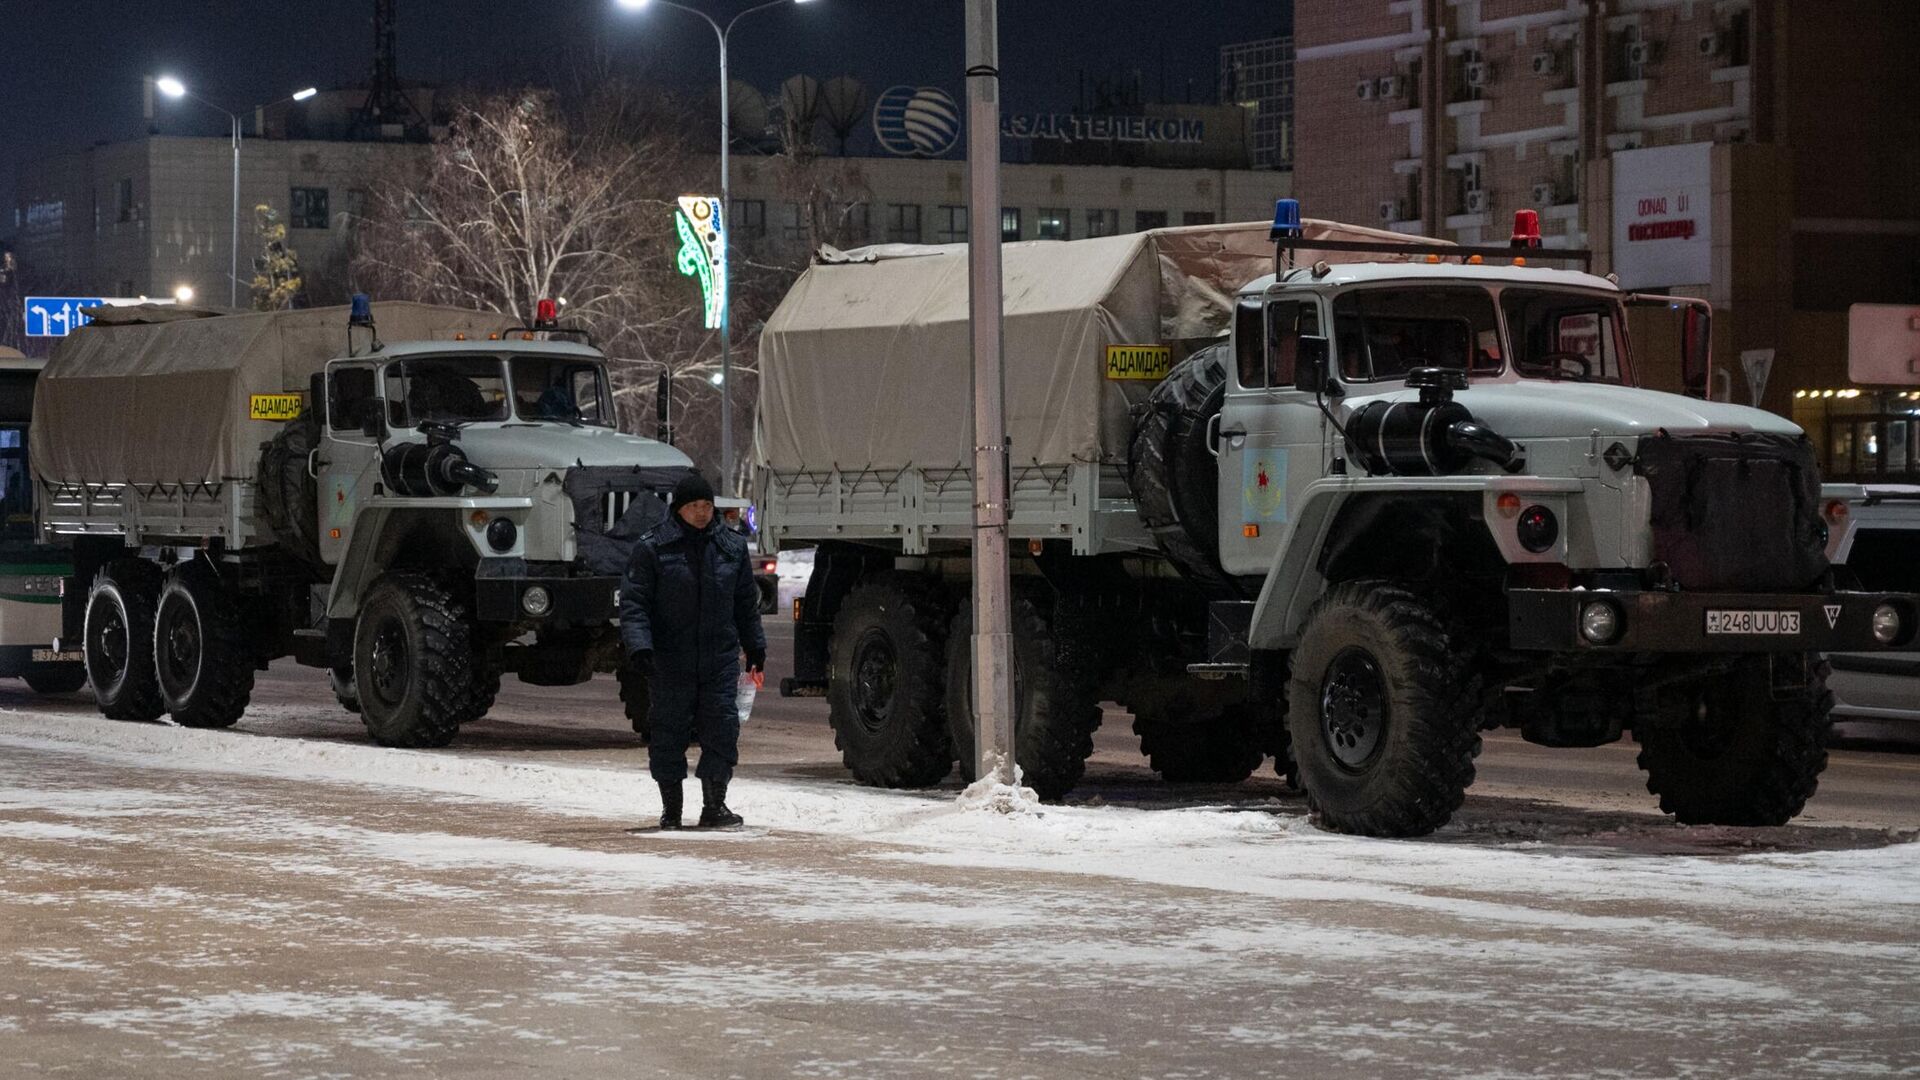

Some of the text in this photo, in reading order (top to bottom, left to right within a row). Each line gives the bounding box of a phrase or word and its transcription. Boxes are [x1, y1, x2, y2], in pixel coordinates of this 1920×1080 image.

[999, 112, 1204, 144] АЗАҚТЕЛЕКОМ
[1110, 351, 1168, 376] АДАМДАР
[253, 398, 300, 417] АДАМДАР
